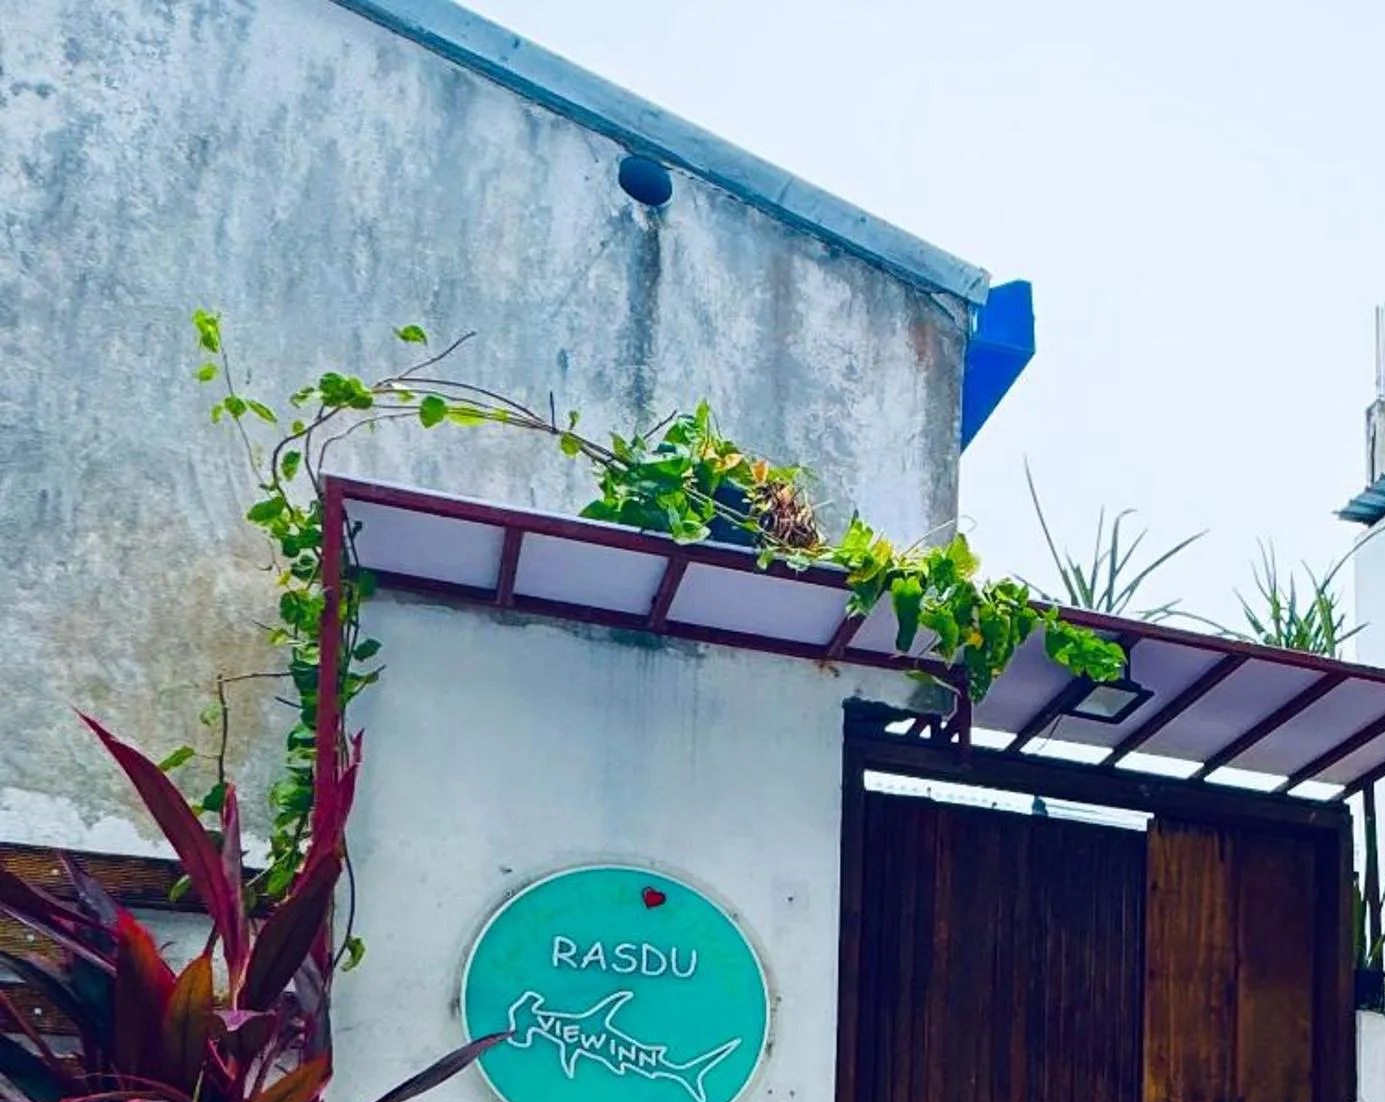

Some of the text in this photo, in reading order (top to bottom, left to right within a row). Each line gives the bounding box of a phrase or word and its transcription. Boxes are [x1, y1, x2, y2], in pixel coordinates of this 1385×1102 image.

[553, 935, 697, 978] RASDU
[536, 1014, 657, 1067] VIEW INN
